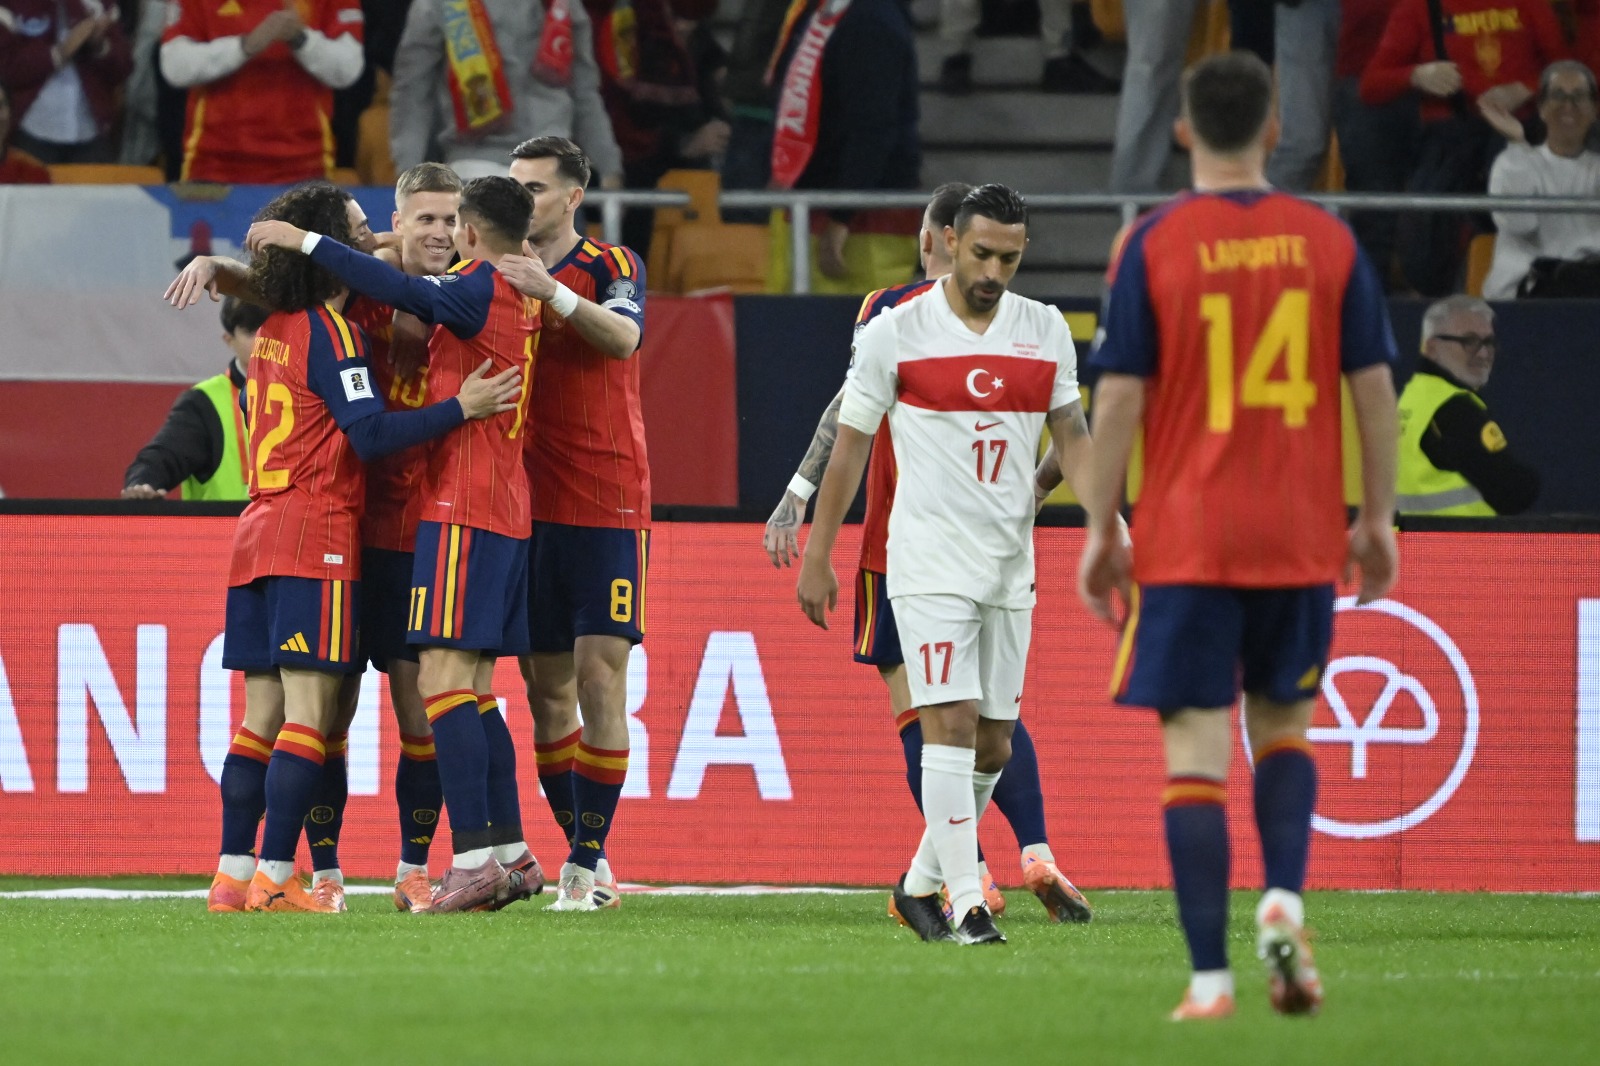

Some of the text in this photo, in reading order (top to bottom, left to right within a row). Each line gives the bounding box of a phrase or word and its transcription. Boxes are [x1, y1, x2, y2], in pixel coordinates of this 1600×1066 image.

[1199, 235, 1309, 273] LAPORTE
[1200, 288, 1318, 433] 14
[246, 378, 294, 489] 22
[971, 439, 1009, 485] 17
[407, 586, 428, 631] 11
[610, 578, 633, 623] 8
[919, 641, 956, 687] 17
